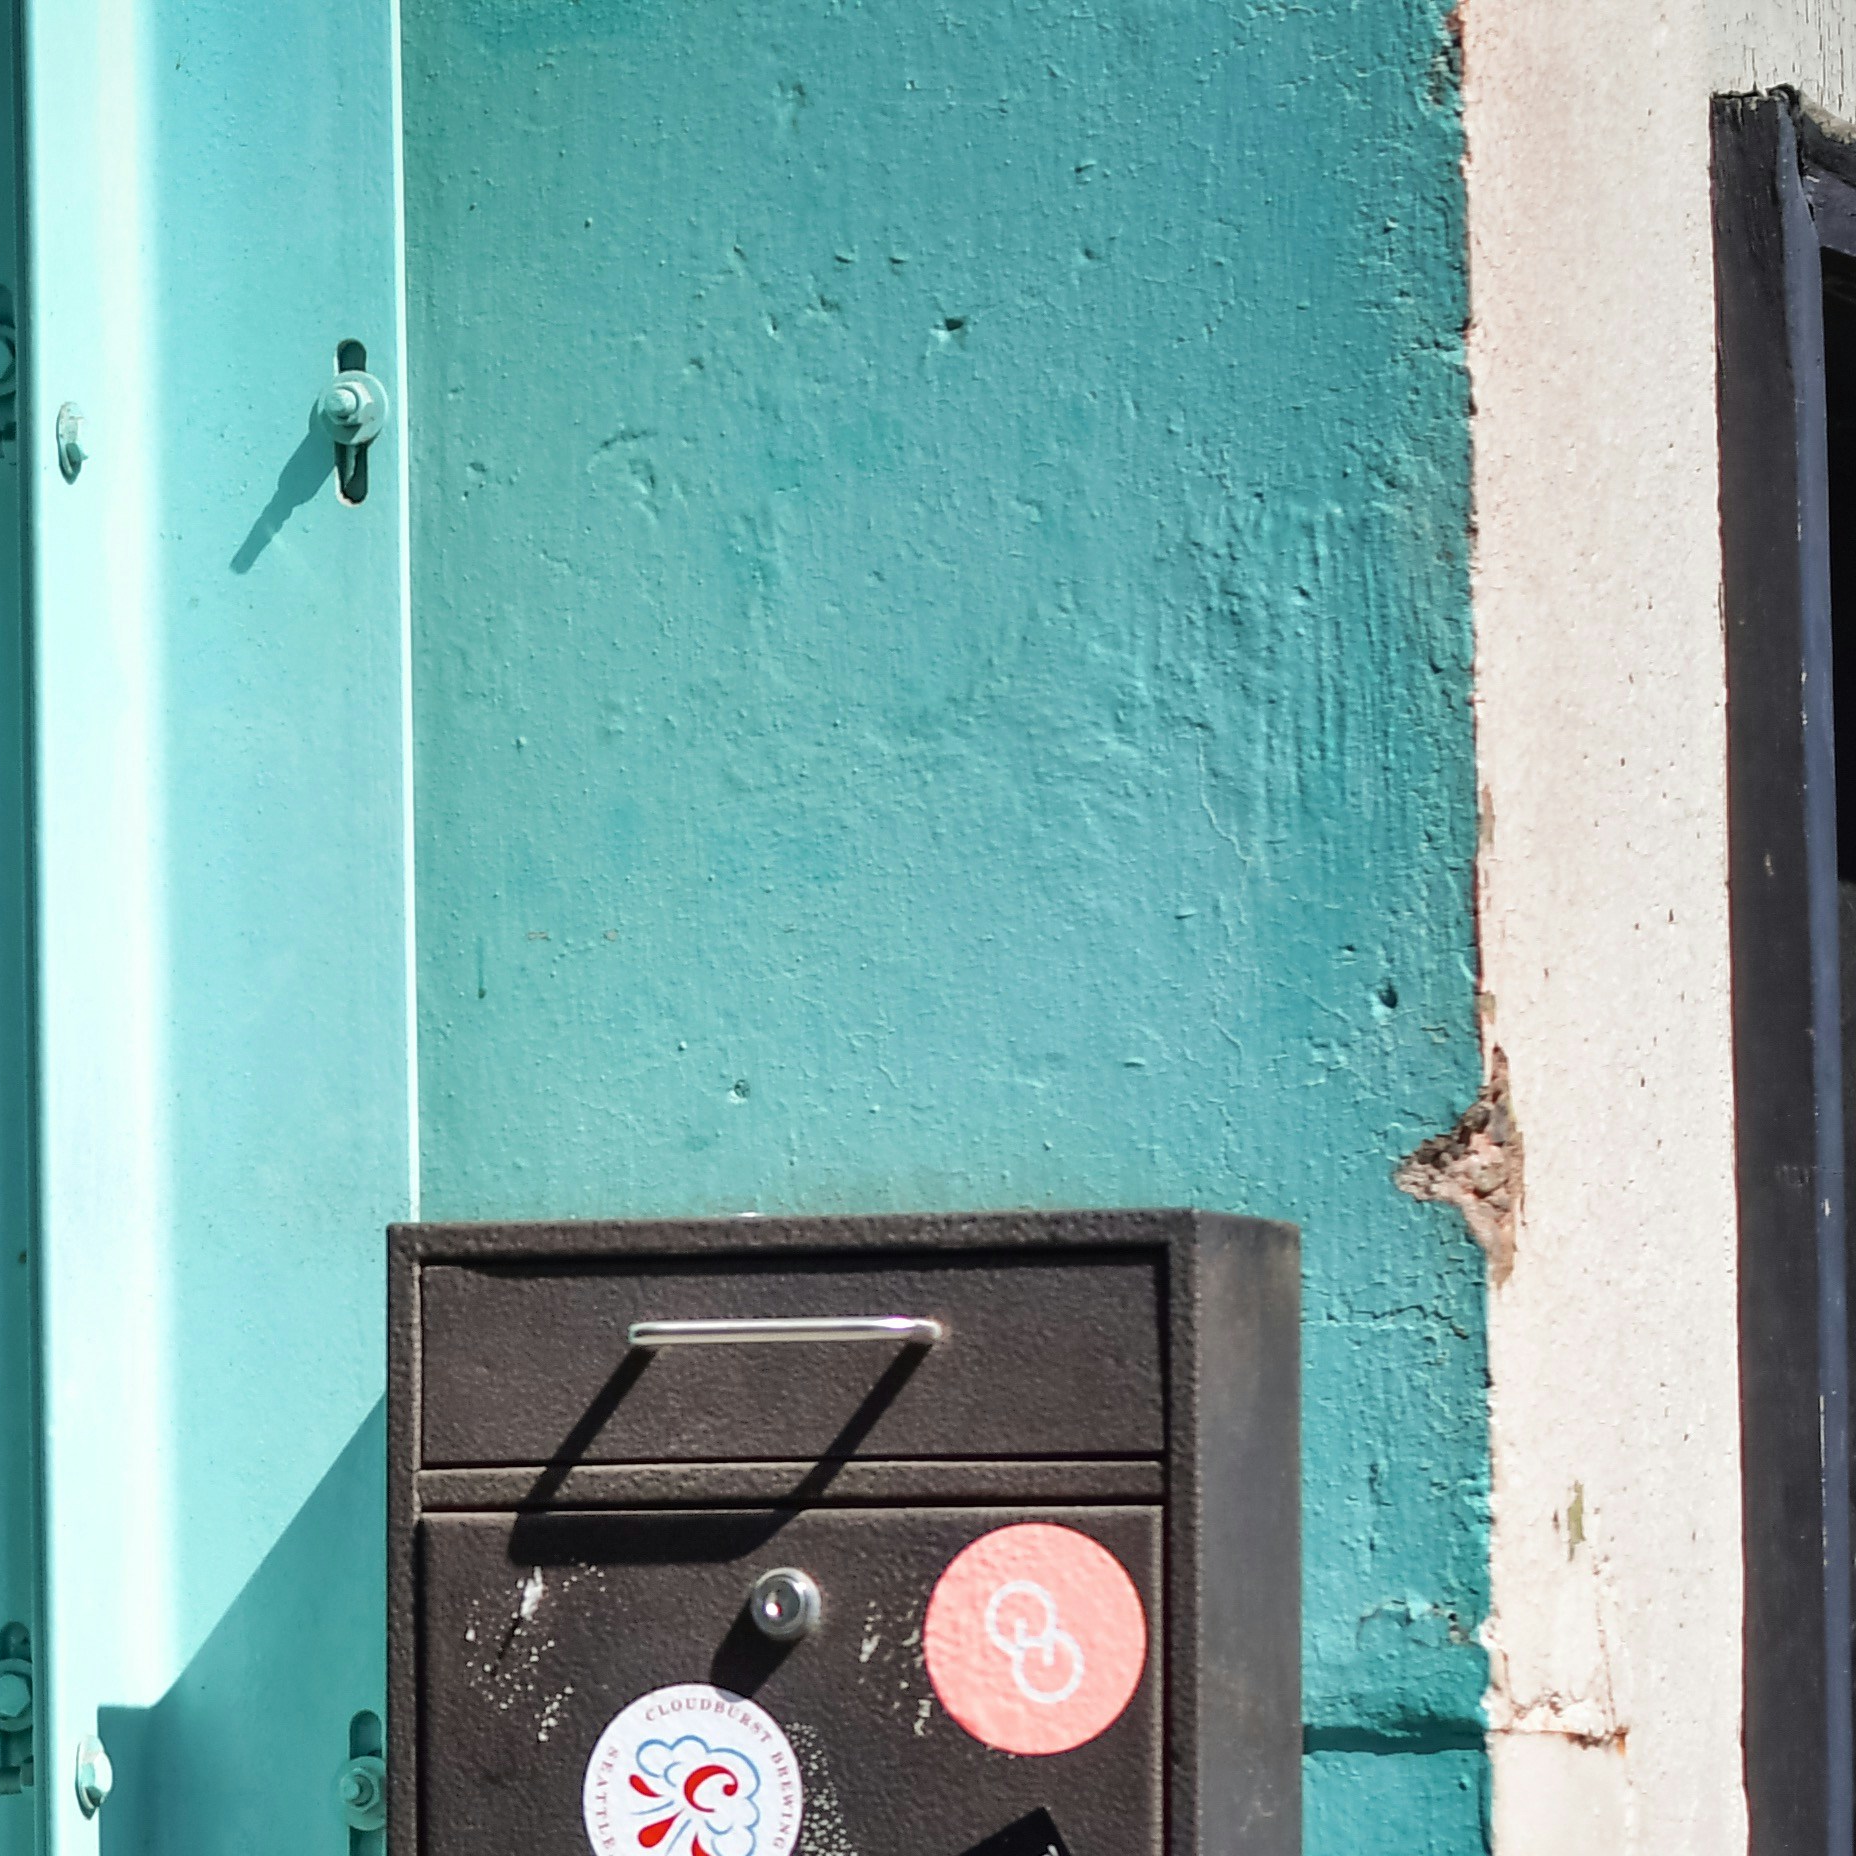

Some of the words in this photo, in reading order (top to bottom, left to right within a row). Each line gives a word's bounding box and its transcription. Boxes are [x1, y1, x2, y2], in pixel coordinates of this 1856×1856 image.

[595, 1746, 619, 1849] SEATTLE
[645, 1698, 773, 1744] CLOUDBURST
[770, 1751, 795, 1850] BREWING
